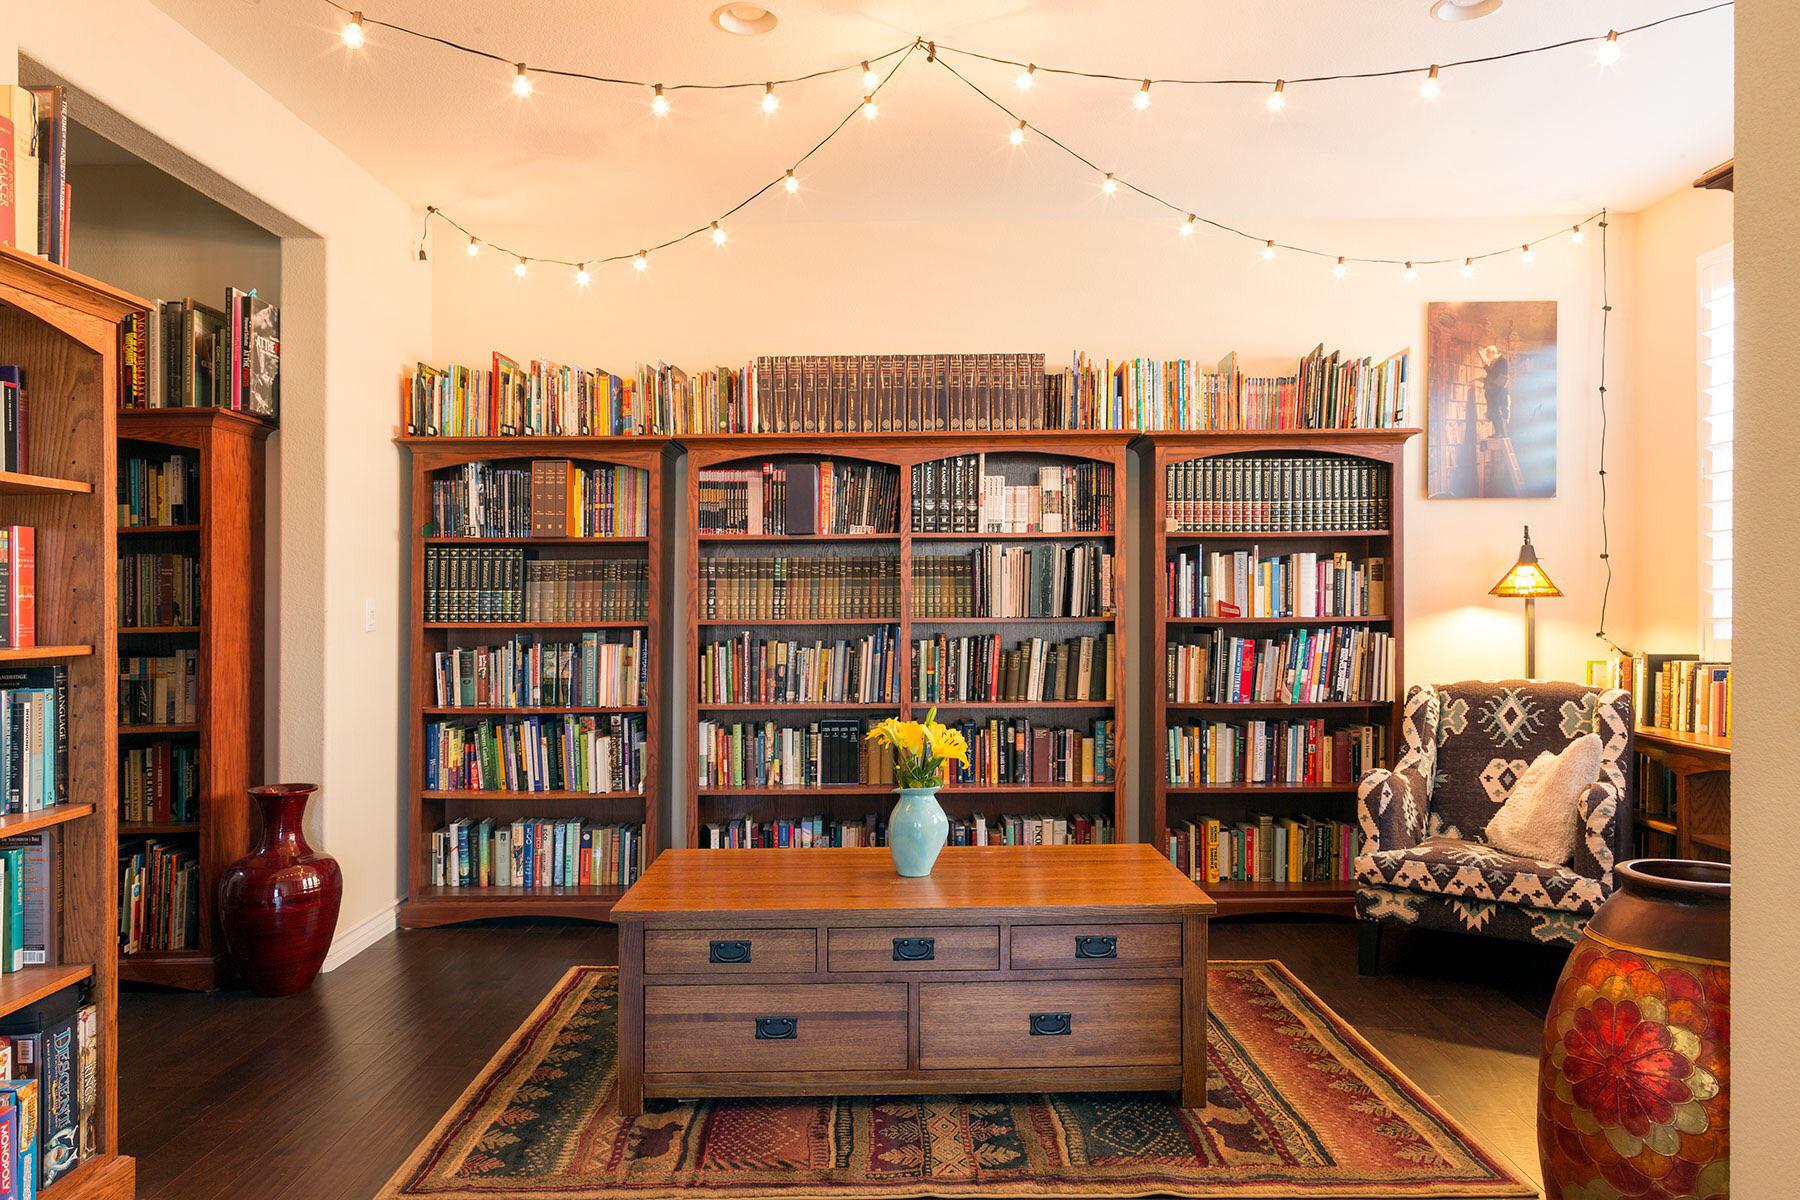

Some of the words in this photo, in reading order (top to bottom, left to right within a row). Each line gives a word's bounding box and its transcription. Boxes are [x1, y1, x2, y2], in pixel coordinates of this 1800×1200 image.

[0, 147, 9, 207] CHAUCER
[145, 767, 153, 807] TOLKIEN
[54, 1027, 71, 1128] DESCENT
[84, 1064, 92, 1103] RINGS
[0, 1122, 10, 1190] MONOPOLY
